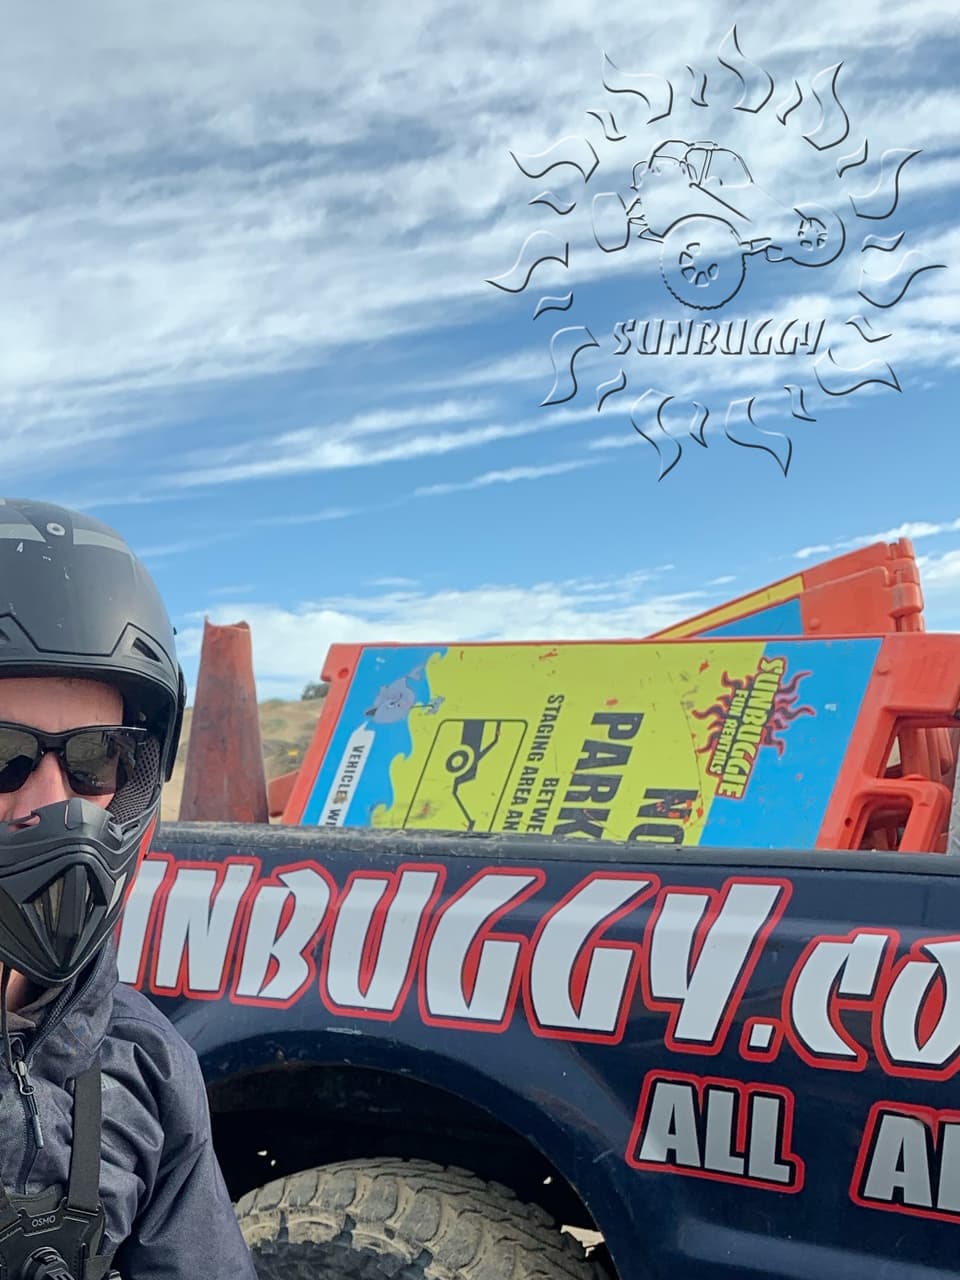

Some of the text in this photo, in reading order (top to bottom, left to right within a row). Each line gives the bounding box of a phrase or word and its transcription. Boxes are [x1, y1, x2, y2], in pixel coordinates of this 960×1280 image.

[527, 694, 565, 762] STAGING
[709, 689, 750, 775] FUN RENTALS
[717, 658, 786, 799] SUNBUGGIE
[511, 766, 540, 806] AREA
[526, 778, 560, 832] BETWE
[552, 712, 645, 840] PARK
[627, 788, 699, 845] NO
[634, 1076, 960, 1215] ALL A
[31, 1215, 56, 1228] OSMO
